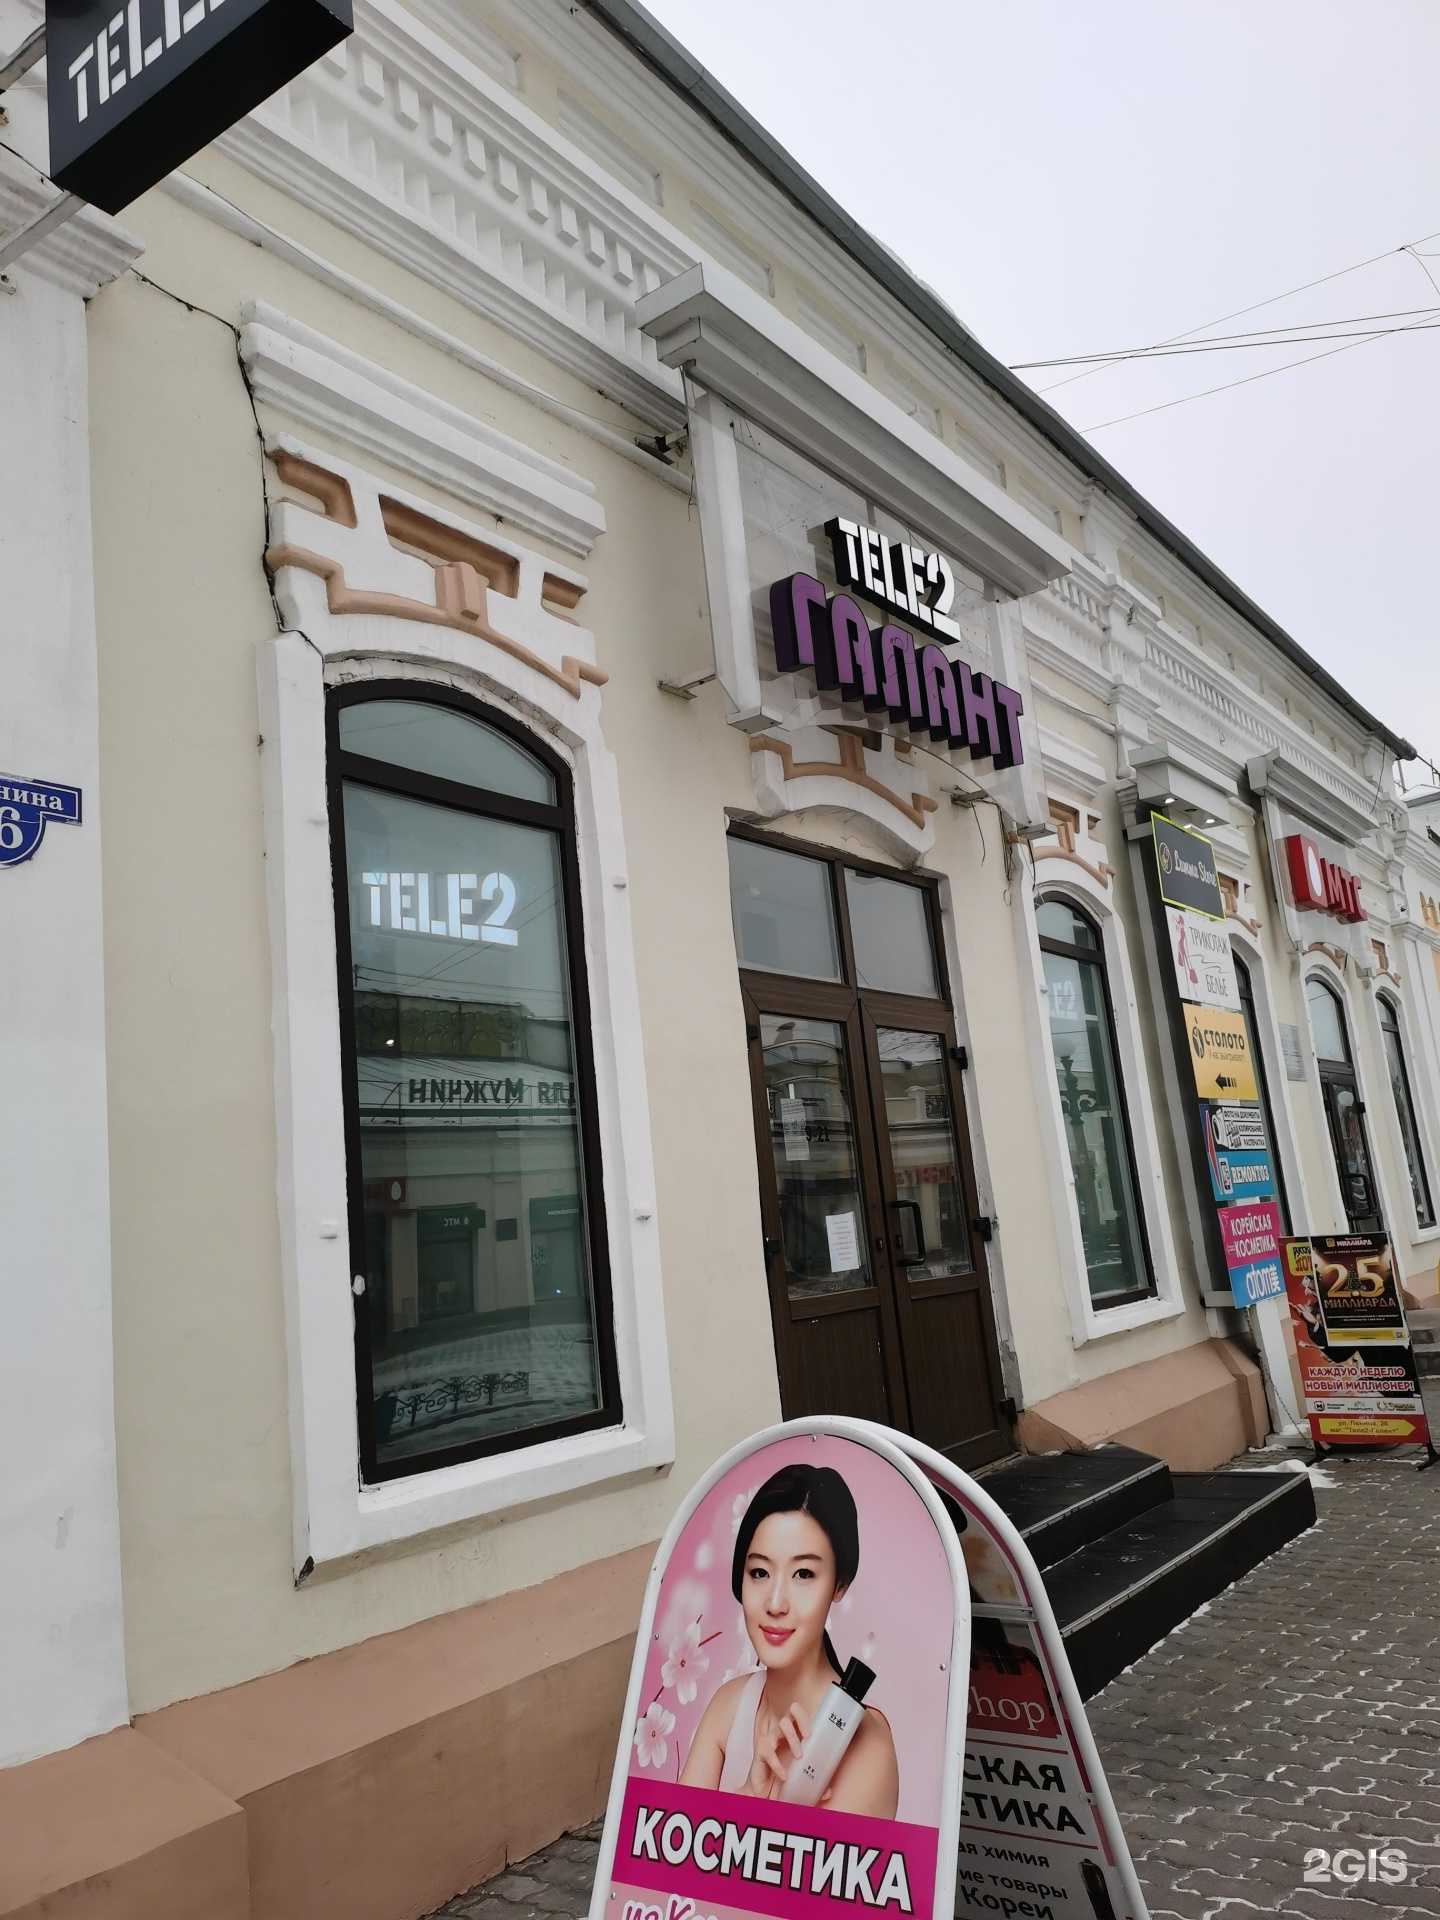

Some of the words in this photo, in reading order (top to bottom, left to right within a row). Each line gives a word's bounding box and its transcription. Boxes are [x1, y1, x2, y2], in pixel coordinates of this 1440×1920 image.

[832, 516, 961, 644] TELE2
[362, 872, 519, 946] TELE2
[1231, 1213, 1273, 1236] КОРЕЙСКАЯ
[1234, 1234, 1277, 1258] КОСМЕТИКА
[1324, 1297, 1396, 1310] МИЛЛИАРДА
[1309, 1367, 1357, 1377] КАЖДУЮ
[1360, 1367, 1405, 1377] НЕДЕЛЮ
[1305, 1381, 1342, 1391] НОВЫЙ
[1346, 1381, 1414, 1392] МИЛЛИОНЕР!
[967, 1686, 1045, 1731] hop
[631, 1806, 913, 1913] КОСМЕТИКА
[982, 1845, 1050, 1868] химия
[988, 1874, 1068, 1900] товары
